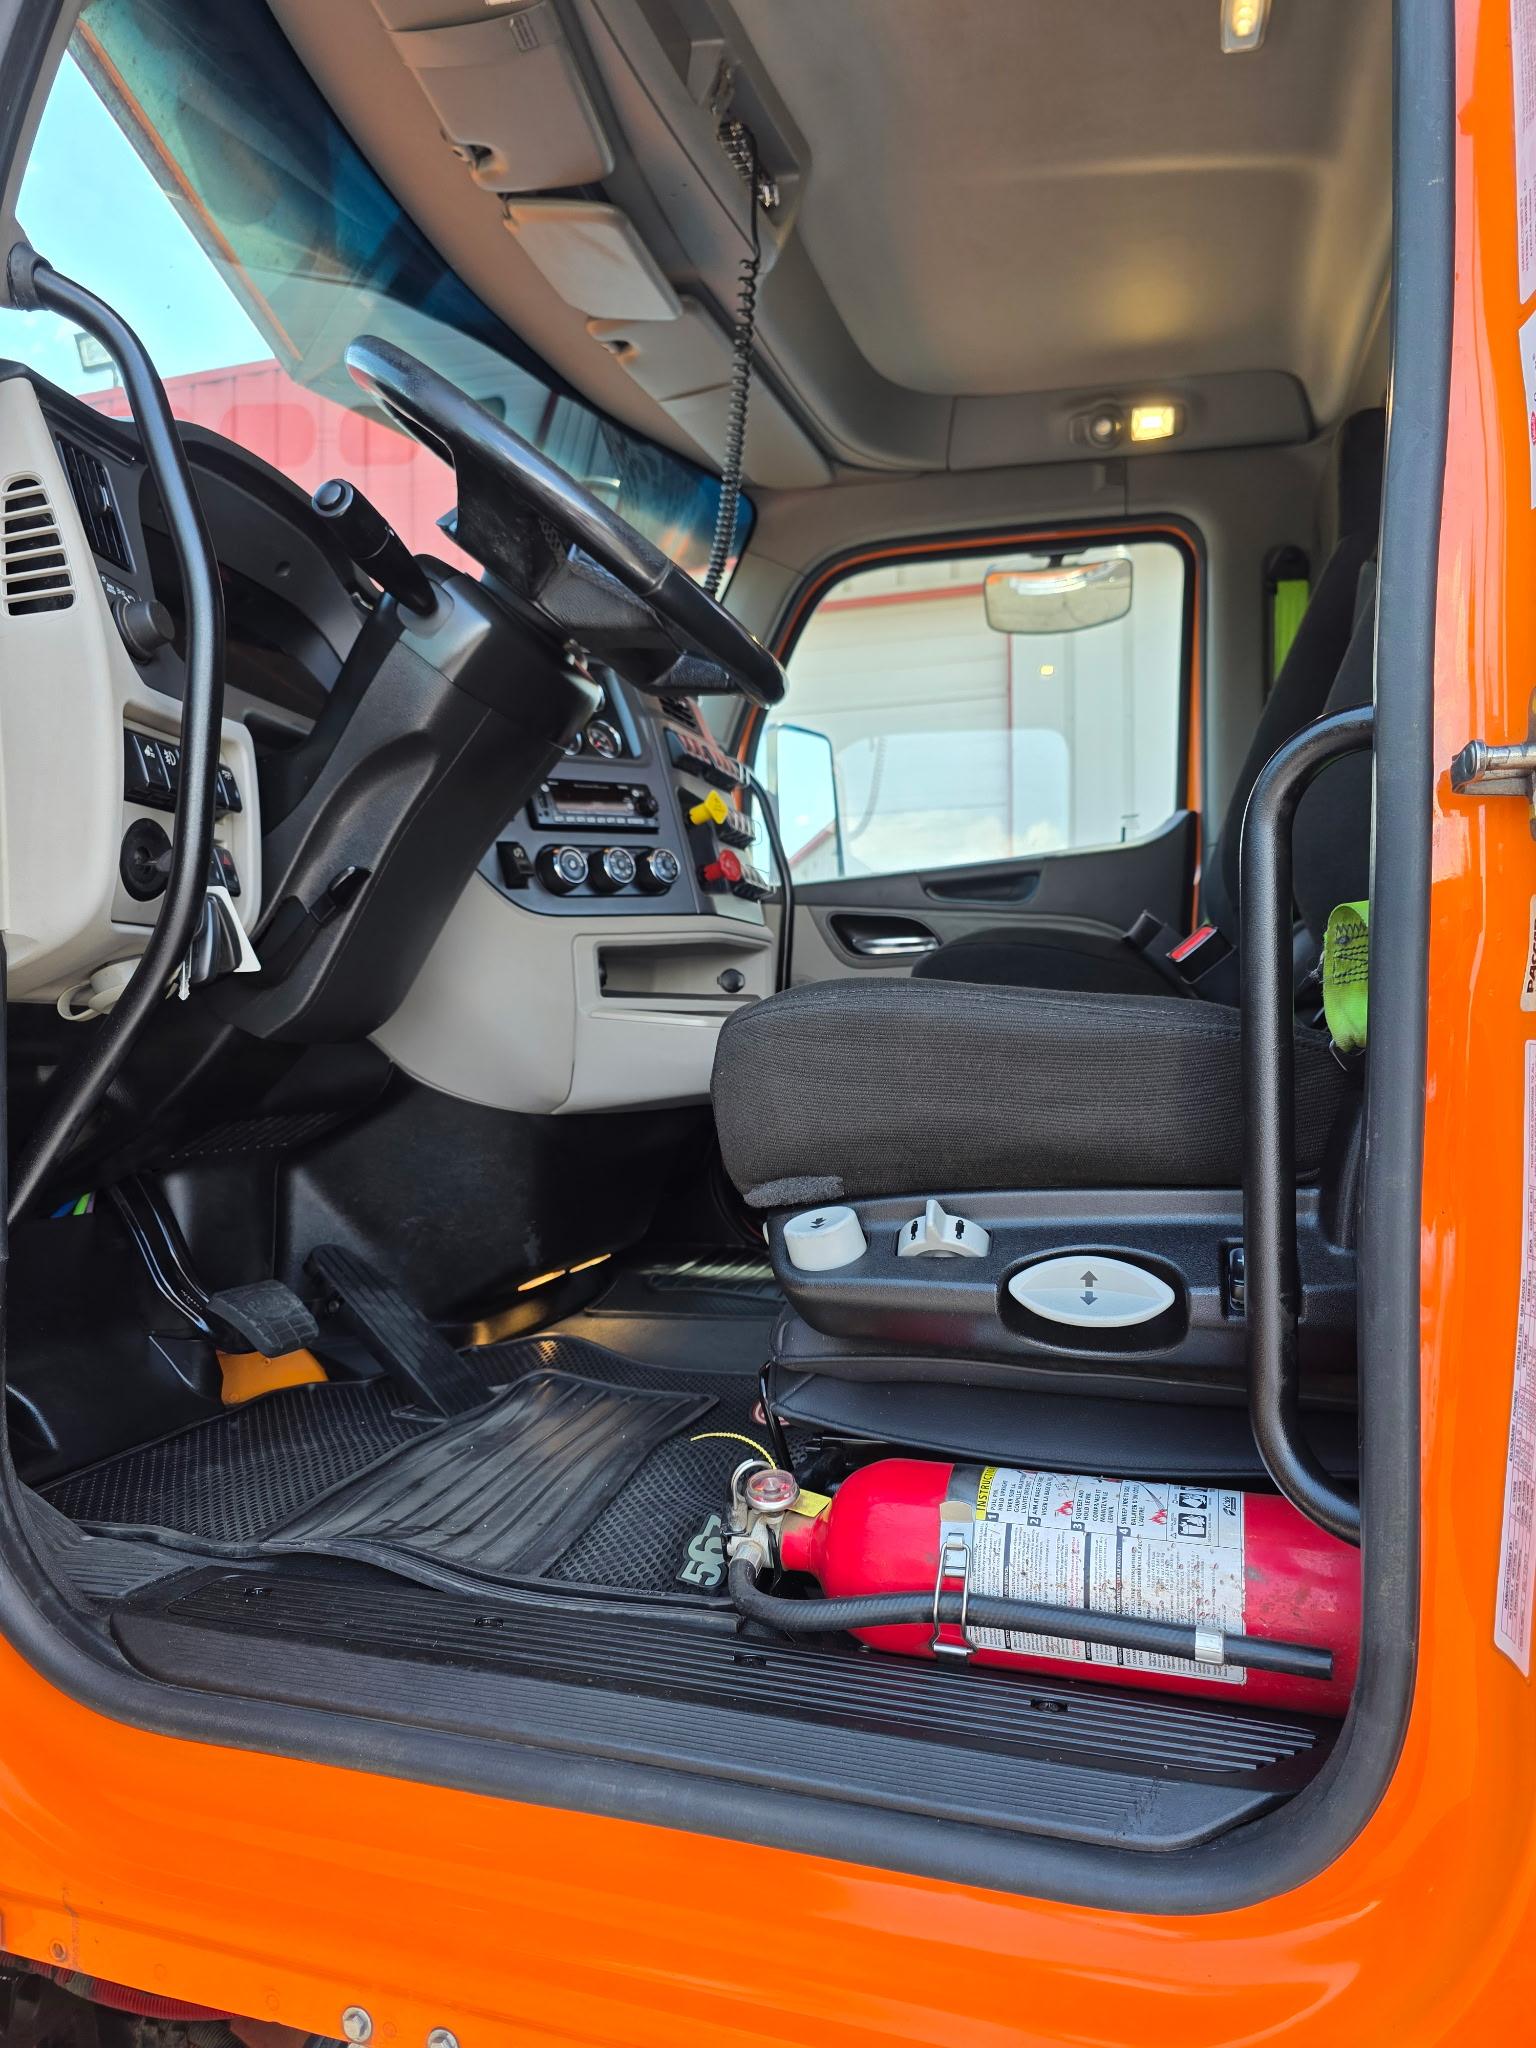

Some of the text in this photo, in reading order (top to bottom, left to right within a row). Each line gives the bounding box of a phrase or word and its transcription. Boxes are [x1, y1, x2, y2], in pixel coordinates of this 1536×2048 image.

[1120, 1507, 1128, 1525] SWEEP
[1029, 1517, 1039, 1525] 2
[1118, 1527, 1130, 1536] 4
